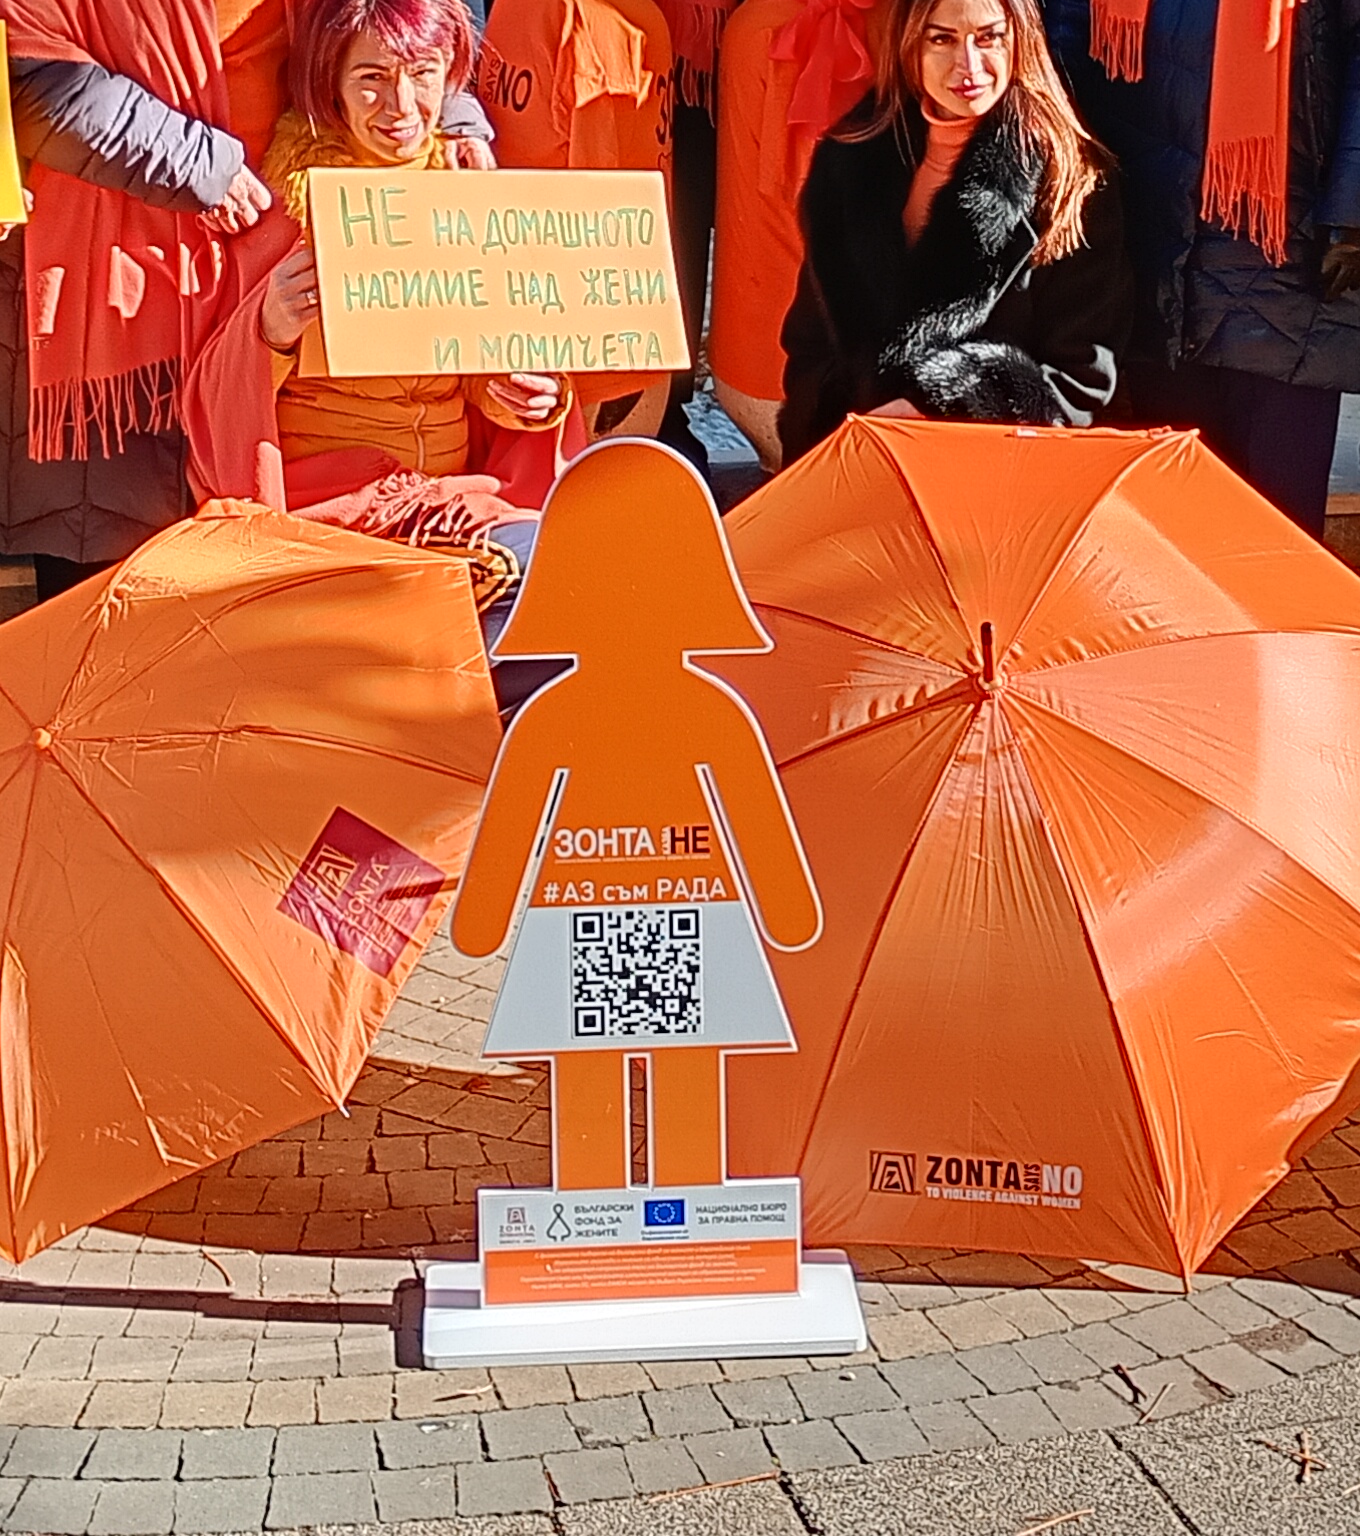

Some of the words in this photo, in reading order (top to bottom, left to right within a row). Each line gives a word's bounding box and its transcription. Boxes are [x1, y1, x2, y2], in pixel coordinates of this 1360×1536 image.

[494, 61, 532, 112] NO
[339, 184, 413, 248] НЕ
[432, 207, 475, 248] НА
[481, 206, 654, 255] ДОМАШНОТО
[344, 268, 489, 313] НАСИЛИЕ
[506, 269, 566, 314] НАД
[579, 267, 667, 306] ЖЕНИ
[433, 337, 460, 371] И
[479, 331, 664, 372] МОМИЧЕТА
[554, 826, 656, 858] ЗОНТА
[670, 825, 710, 854] НЕ
[602, 884, 648, 902] съм
[656, 876, 727, 902] РАДА
[925, 1156, 1022, 1191] ZONTA
[1023, 1163, 1041, 1192] SAYS
[1042, 1164, 1083, 1196] NO
[574, 1204, 634, 1214] БЪЛГАРСКИ
[696, 1204, 758, 1214] НАЦИОНАЛНО
[925, 1186, 941, 1199] TO
[942, 1187, 993, 1203] VIOLENCE
[994, 1192, 1039, 1207] AGAINST
[1040, 1196, 1082, 1210] WOMEN
[574, 1228, 619, 1238] ЖЕНИТЕ
[607, 1216, 622, 1225] ЗА
